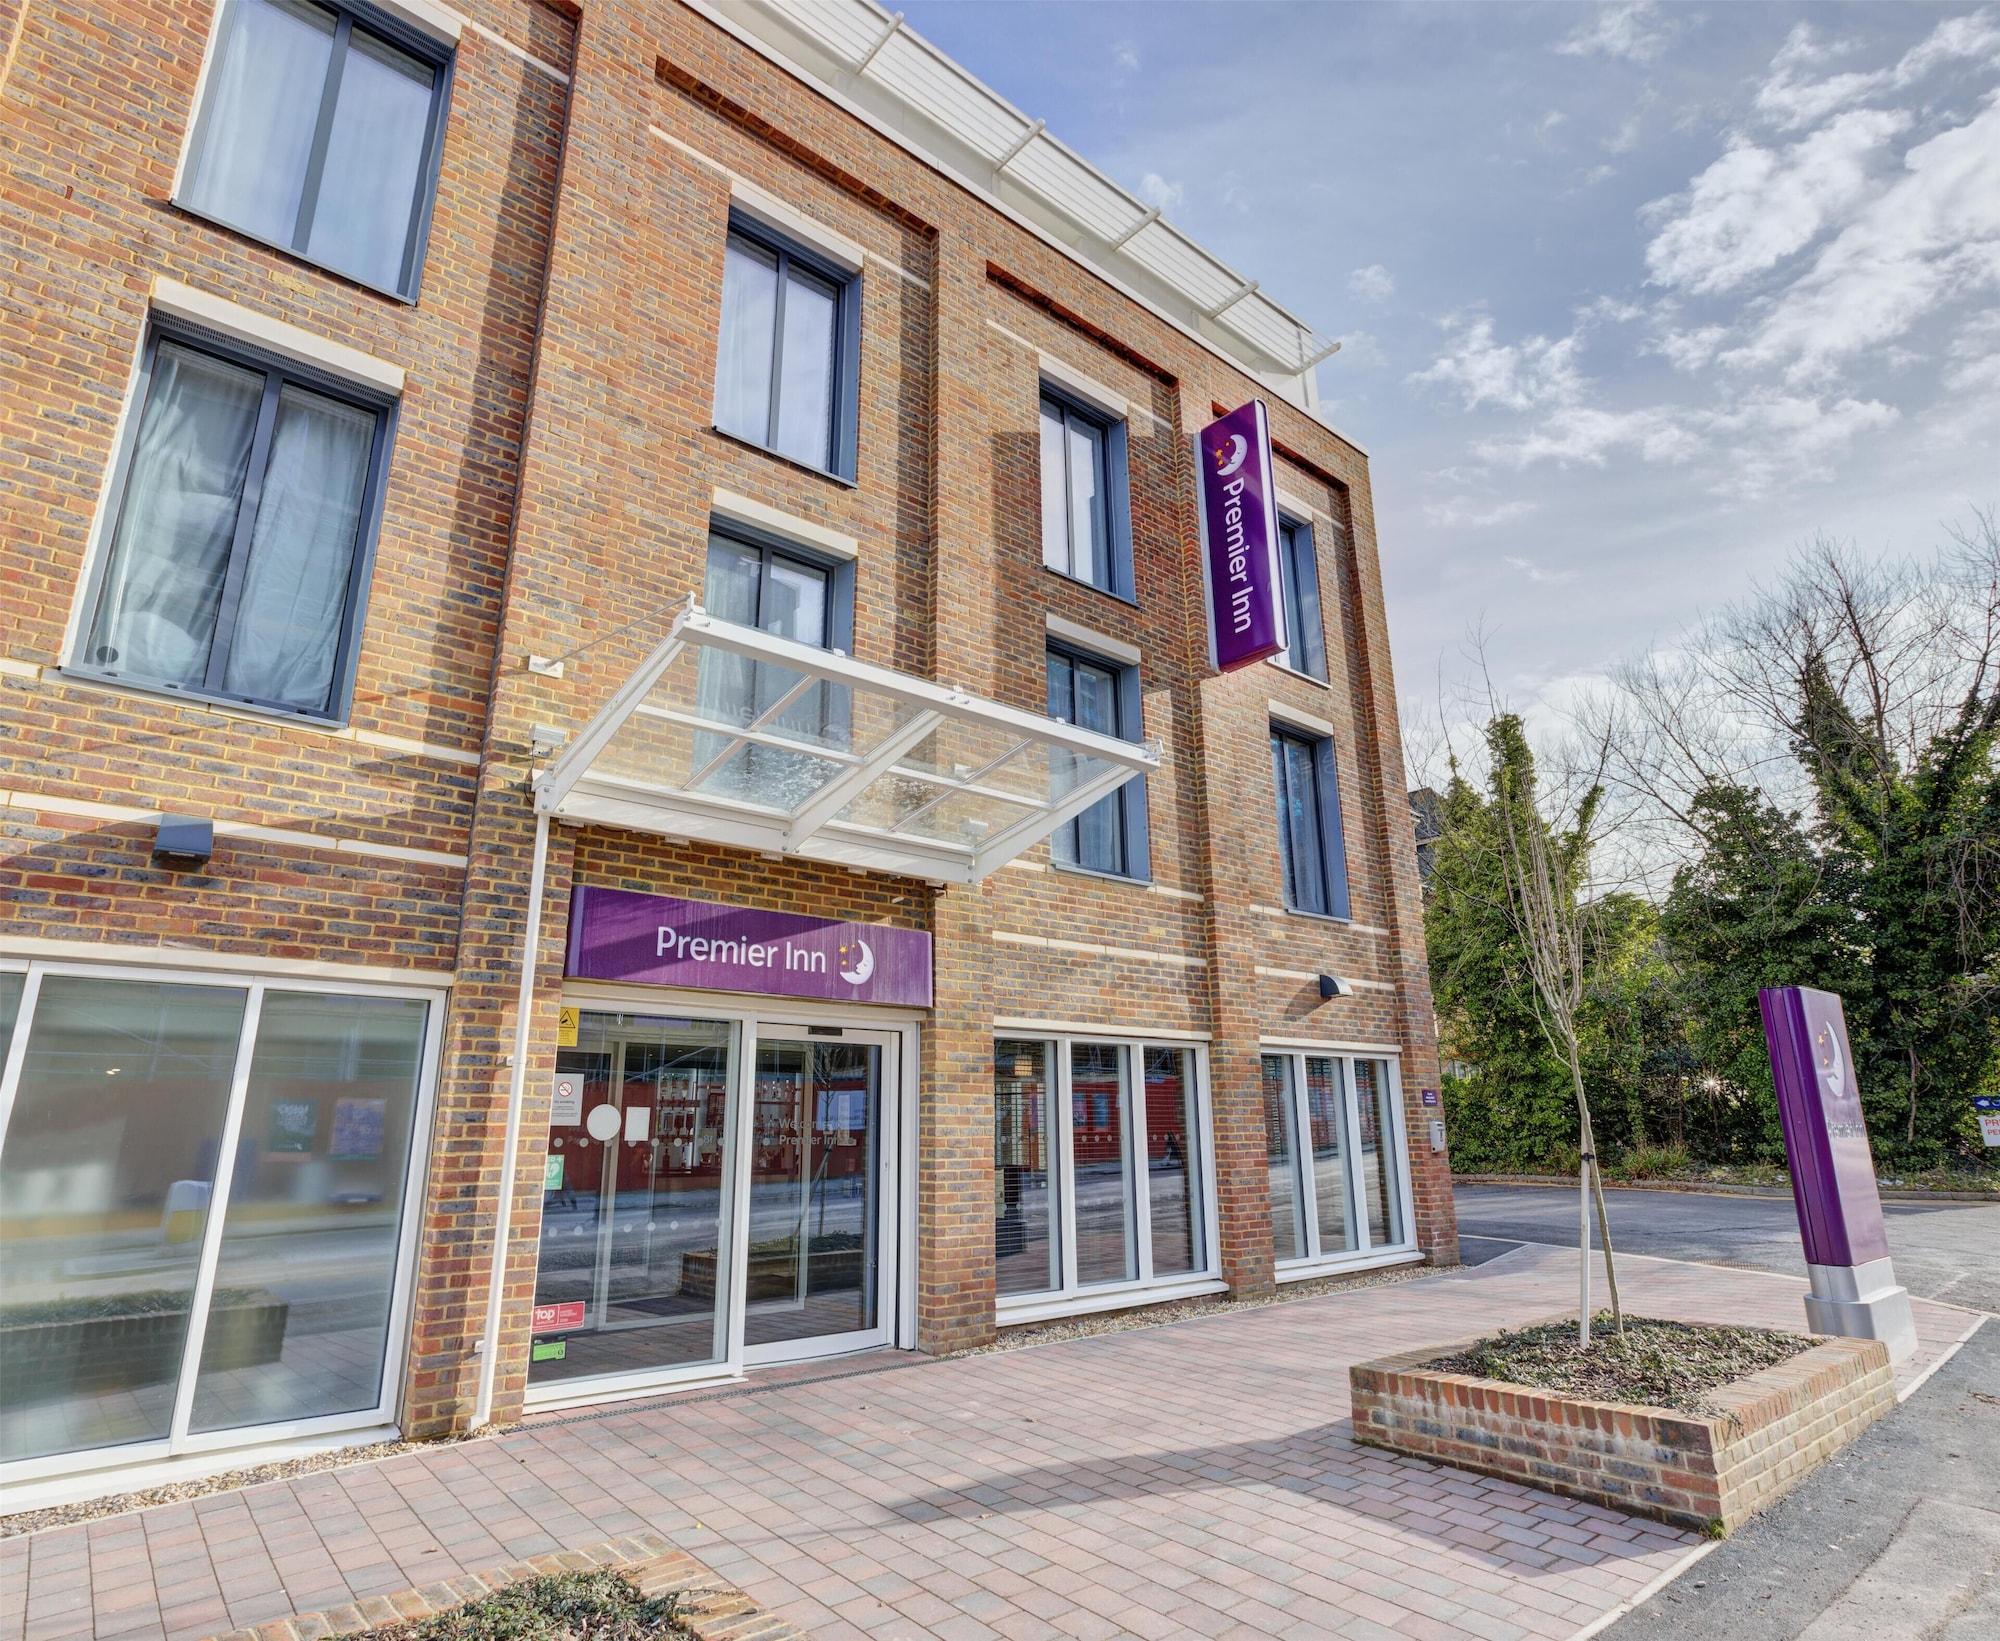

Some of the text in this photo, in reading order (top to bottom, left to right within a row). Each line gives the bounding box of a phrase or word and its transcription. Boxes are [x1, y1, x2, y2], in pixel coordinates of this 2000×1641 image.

[1223, 477, 1254, 634] Premier Inn
[656, 926, 827, 973] Premier Inn
